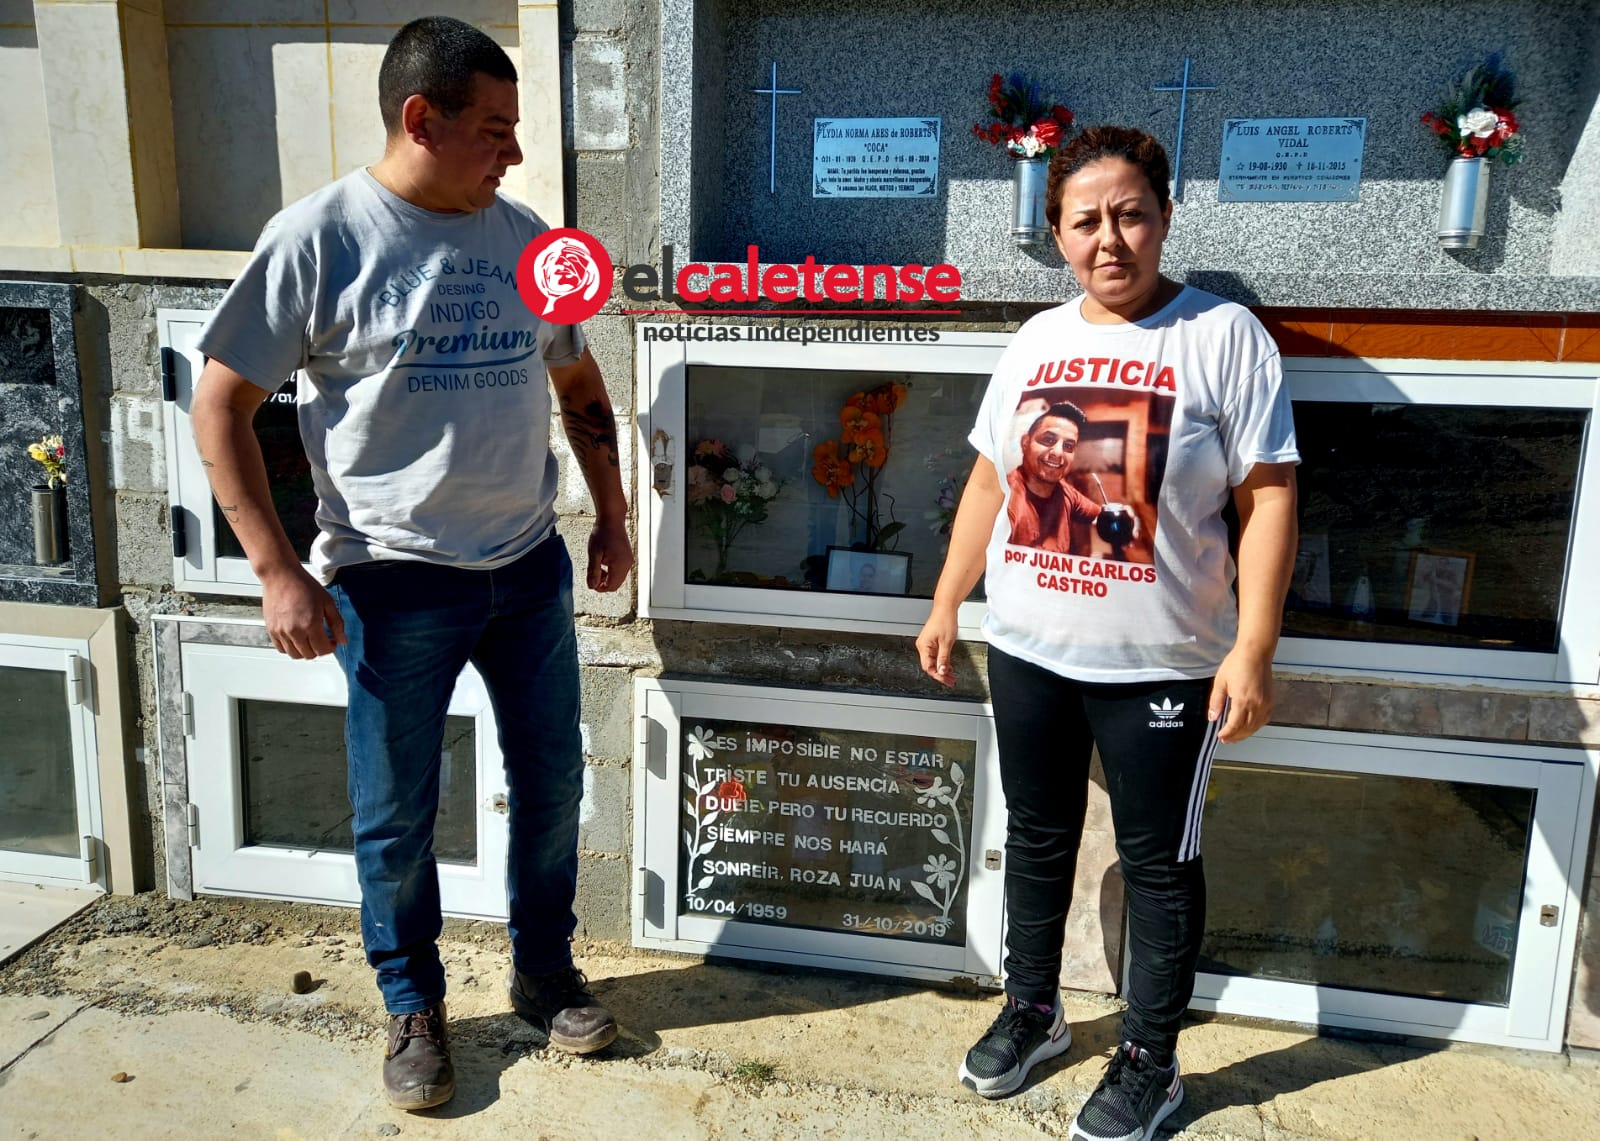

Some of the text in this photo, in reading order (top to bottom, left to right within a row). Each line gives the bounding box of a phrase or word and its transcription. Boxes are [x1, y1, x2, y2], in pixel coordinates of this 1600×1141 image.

[821, 127, 932, 139] LYDIA NORMA ARES de ROBERTS
[1236, 125, 1353, 136] LUIS ANGEL ROBERTS
[1277, 138, 1309, 148] VIDAL
[379, 263, 437, 307] BLUE
[440, 257, 457, 275] &
[437, 283, 486, 296] DESING
[430, 300, 500, 323] INDIGO
[392, 325, 537, 358] Premium
[408, 369, 528, 393] DENIM GOODS
[1027, 357, 1177, 392] JUSTICIA
[1004, 548, 1157, 583] por JUAN CARLOS
[1036, 572, 1108, 598] CASTRO
[1149, 720, 1184, 728] adidas
[715, 736, 737, 751] ES
[850, 746, 878, 762] NO
[885, 749, 944, 769] ESTAR
[703, 763, 900, 795] TRISTE TU AUSENCIA
[768, 801, 816, 819] PERO
[824, 806, 847, 822] TU
[851, 807, 948, 829] RECUERDO
[706, 822, 889, 856] SIEMPRE NOS HARÁ
[790, 867, 841, 887] ROZA
[850, 873, 901, 892] JUAN
[686, 895, 947, 938] 10/04/1959 31/10/2019
